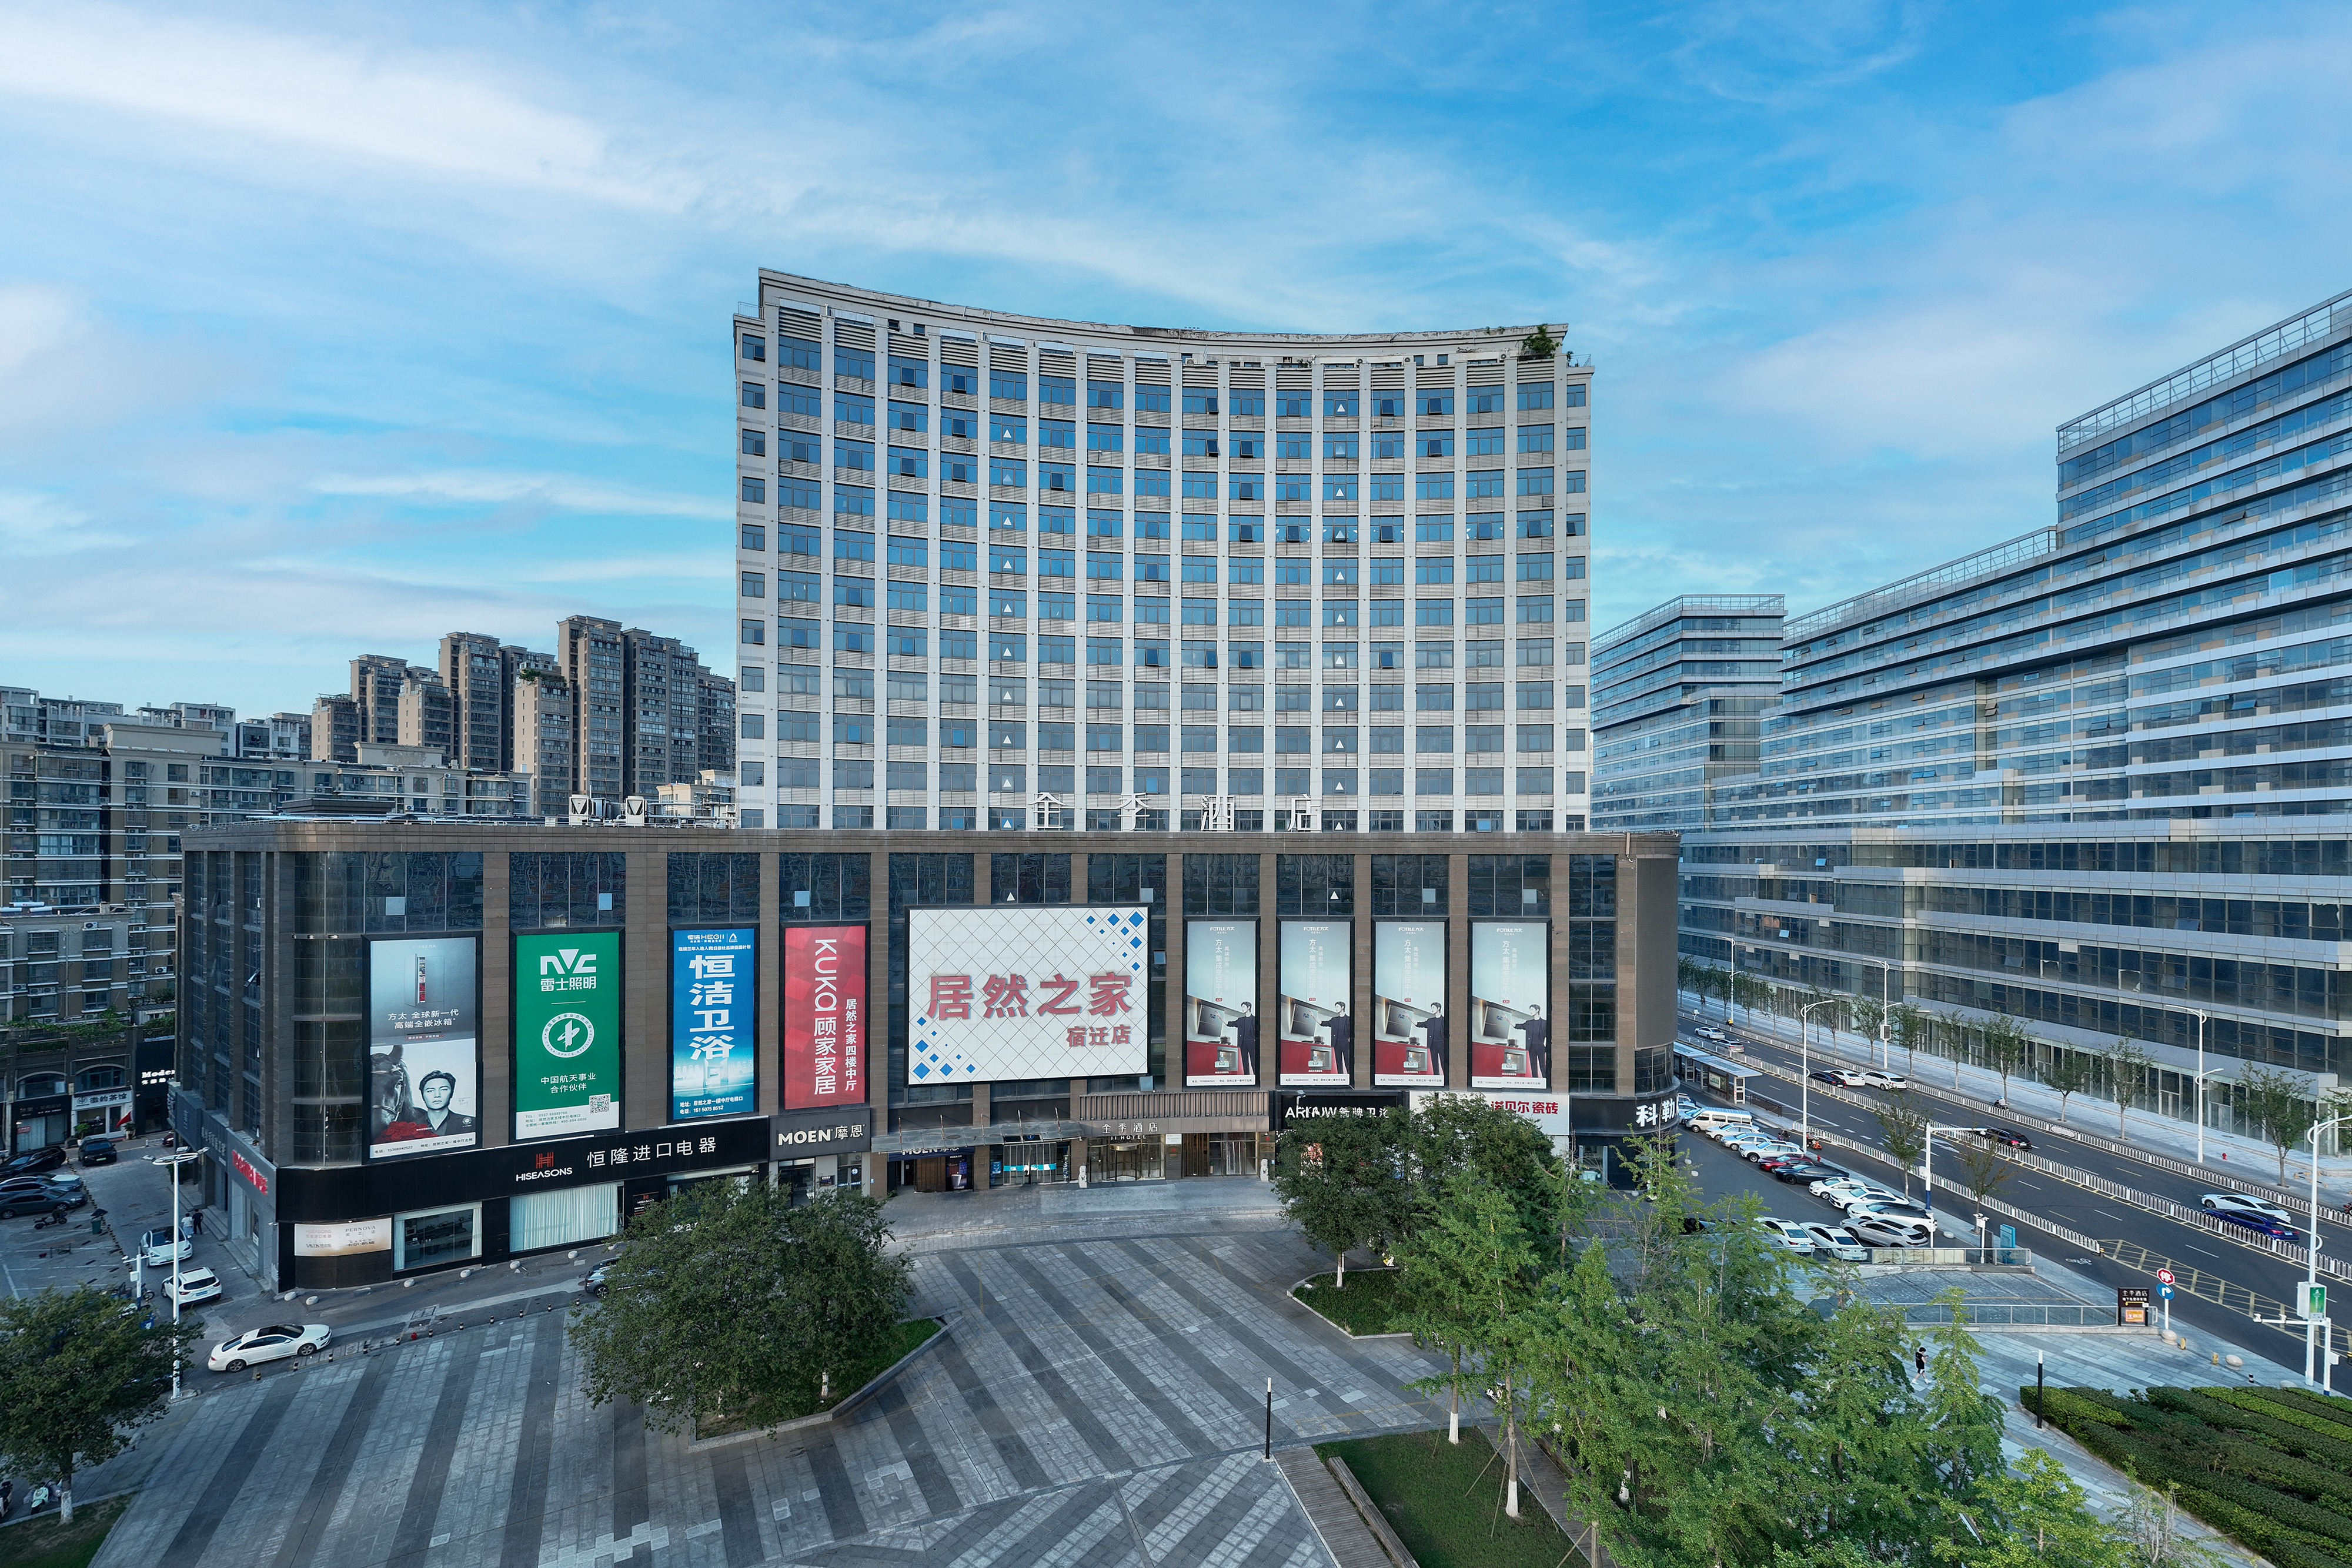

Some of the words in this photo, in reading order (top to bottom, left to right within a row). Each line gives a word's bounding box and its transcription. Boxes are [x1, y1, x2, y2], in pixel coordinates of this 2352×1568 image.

[1029, 792, 1322, 831] 全季酒店
[1215, 939, 1222, 953] 方太
[1309, 939, 1316, 953] 方太
[1404, 940, 1411, 954] 方太
[1502, 941, 1510, 955] 方太
[540, 976, 597, 992] 雷士照明
[926, 971, 1132, 1021] 居然之家
[388, 1012, 407, 1021] 方太
[412, 1009, 459, 1019] 全球新一代
[689, 955, 736, 1060] 恒洁卫浴
[395, 1018, 452, 1029] 高端全嵌冰箱
[1066, 1024, 1131, 1048] 宿迁店
[845, 998, 858, 1091] 居然之家四楼中厅
[814, 1017, 837, 1095] 顾家家居
[540, 1072, 596, 1085] 中国航天事业
[550, 1083, 587, 1094] 合作伙伴
[1636, 1098, 1675, 1127] 科勒
[778, 1129, 831, 1145] MOEN
[834, 1124, 864, 1140] 摩恩
[1102, 1122, 1158, 1134] 全季酒店
[587, 1136, 716, 1168] 恒隆进口电器
[516, 1167, 573, 1182] HISEASONS
